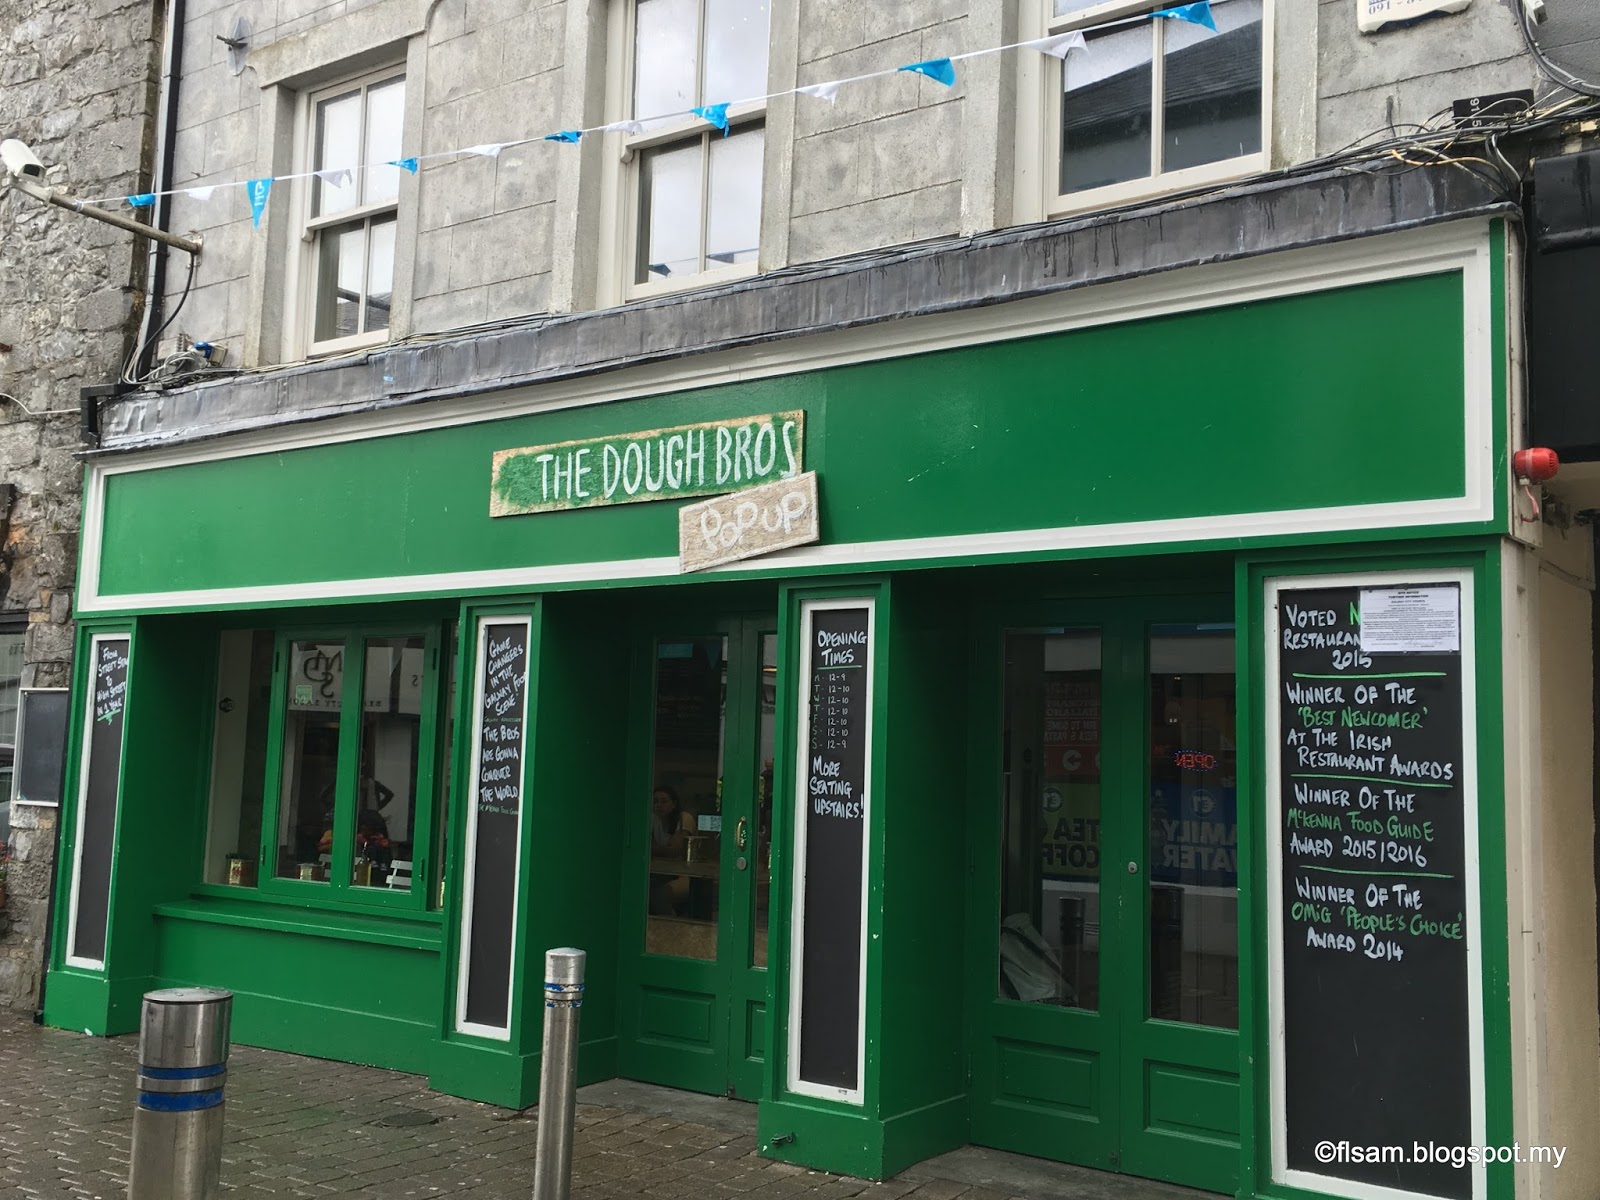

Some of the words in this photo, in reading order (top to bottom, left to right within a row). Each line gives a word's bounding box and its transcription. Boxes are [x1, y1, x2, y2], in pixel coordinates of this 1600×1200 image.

[536, 449, 592, 502] THE
[602, 430, 704, 499] DOUGH
[716, 420, 797, 486] BROS
[1286, 604, 1337, 627] VOTED
[1350, 602, 1360, 626] N
[489, 636, 512, 658] GAME
[817, 630, 868, 648] OPENING
[1284, 628, 1360, 650] RESTAURAN
[98, 660, 117, 677] STREET
[488, 644, 524, 676] CHANGERS
[821, 649, 855, 667] TIMES
[1332, 650, 1372, 670] 2015
[106, 675, 112, 686] TO
[490, 676, 500, 688] IN
[498, 664, 514, 682] THE
[110, 681, 126, 698] STREET
[484, 683, 512, 709] GALWAY
[1286, 682, 1346, 705] WINNER
[1354, 684, 1378, 704] OF
[1385, 682, 1416, 705] THE
[96, 706, 103, 716] IN
[104, 702, 110, 714] 1
[484, 726, 498, 742] THE
[500, 724, 520, 742] BROS
[1287, 728, 1306, 746] AT
[1312, 728, 1338, 747] THE
[1350, 730, 1392, 752] IRISH
[482, 748, 495, 764] ARE
[495, 746, 519, 762] GONNA
[812, 755, 840, 776] MORE
[1297, 746, 1384, 772] RESTAURANT
[1390, 754, 1454, 780] AWARDS
[481, 765, 512, 782] CONQUER
[480, 786, 494, 803] THE
[494, 784, 518, 802] WORLD
[809, 776, 852, 798] SEATING
[1294, 782, 1350, 807] WINNER
[1358, 786, 1380, 810] OF
[1384, 789, 1416, 813] THE
[814, 794, 864, 819] UPSTAIRS!
[1346, 811, 1384, 834] FOOD
[1386, 816, 1434, 842] GUIDE
[1290, 832, 1333, 858] AWARD
[1296, 876, 1355, 905] WINNER
[1365, 883, 1388, 908] OF
[1392, 884, 1423, 910] THE
[1307, 926, 1356, 952] AWARD
[1363, 933, 1404, 962] 2014
